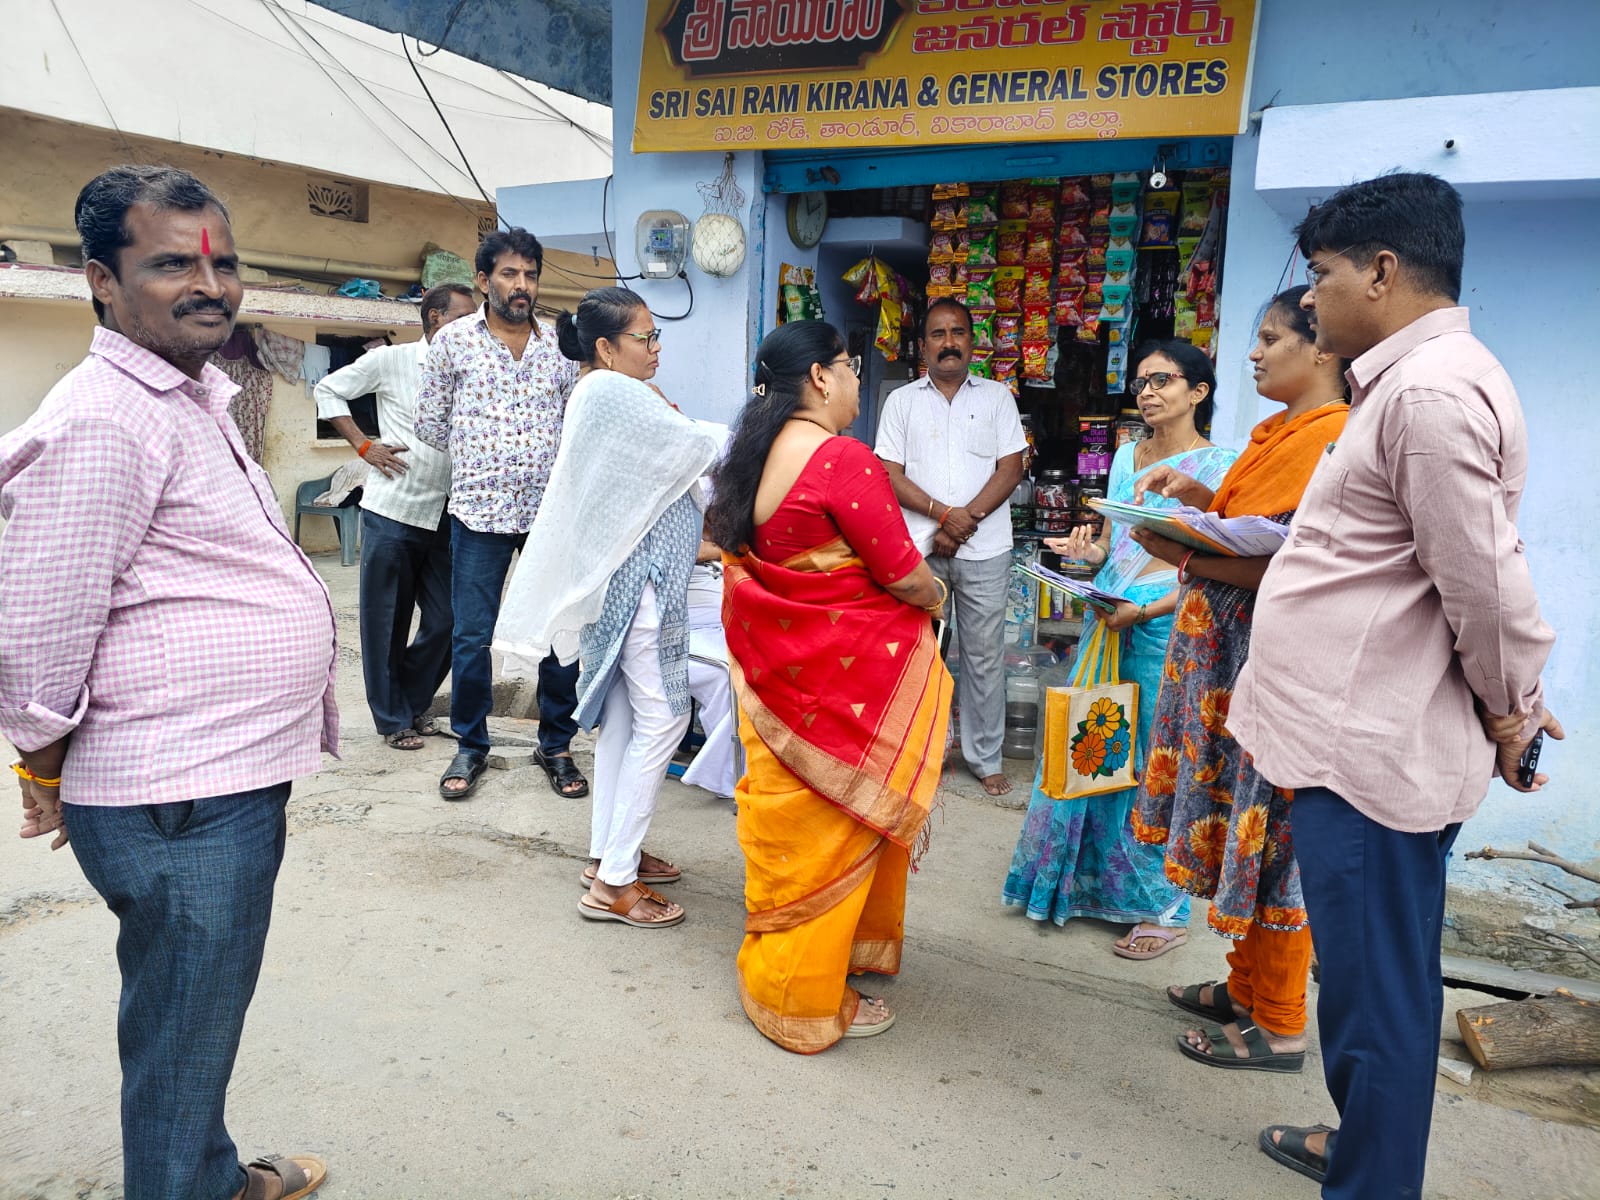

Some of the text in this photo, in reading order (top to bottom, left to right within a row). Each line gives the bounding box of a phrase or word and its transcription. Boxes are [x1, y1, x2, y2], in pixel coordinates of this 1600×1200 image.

[650, 60, 1228, 119] SRI SAI RAM KIRANA & GENERAL STORES
[931, 107, 1055, 134] వికారాబాద్
